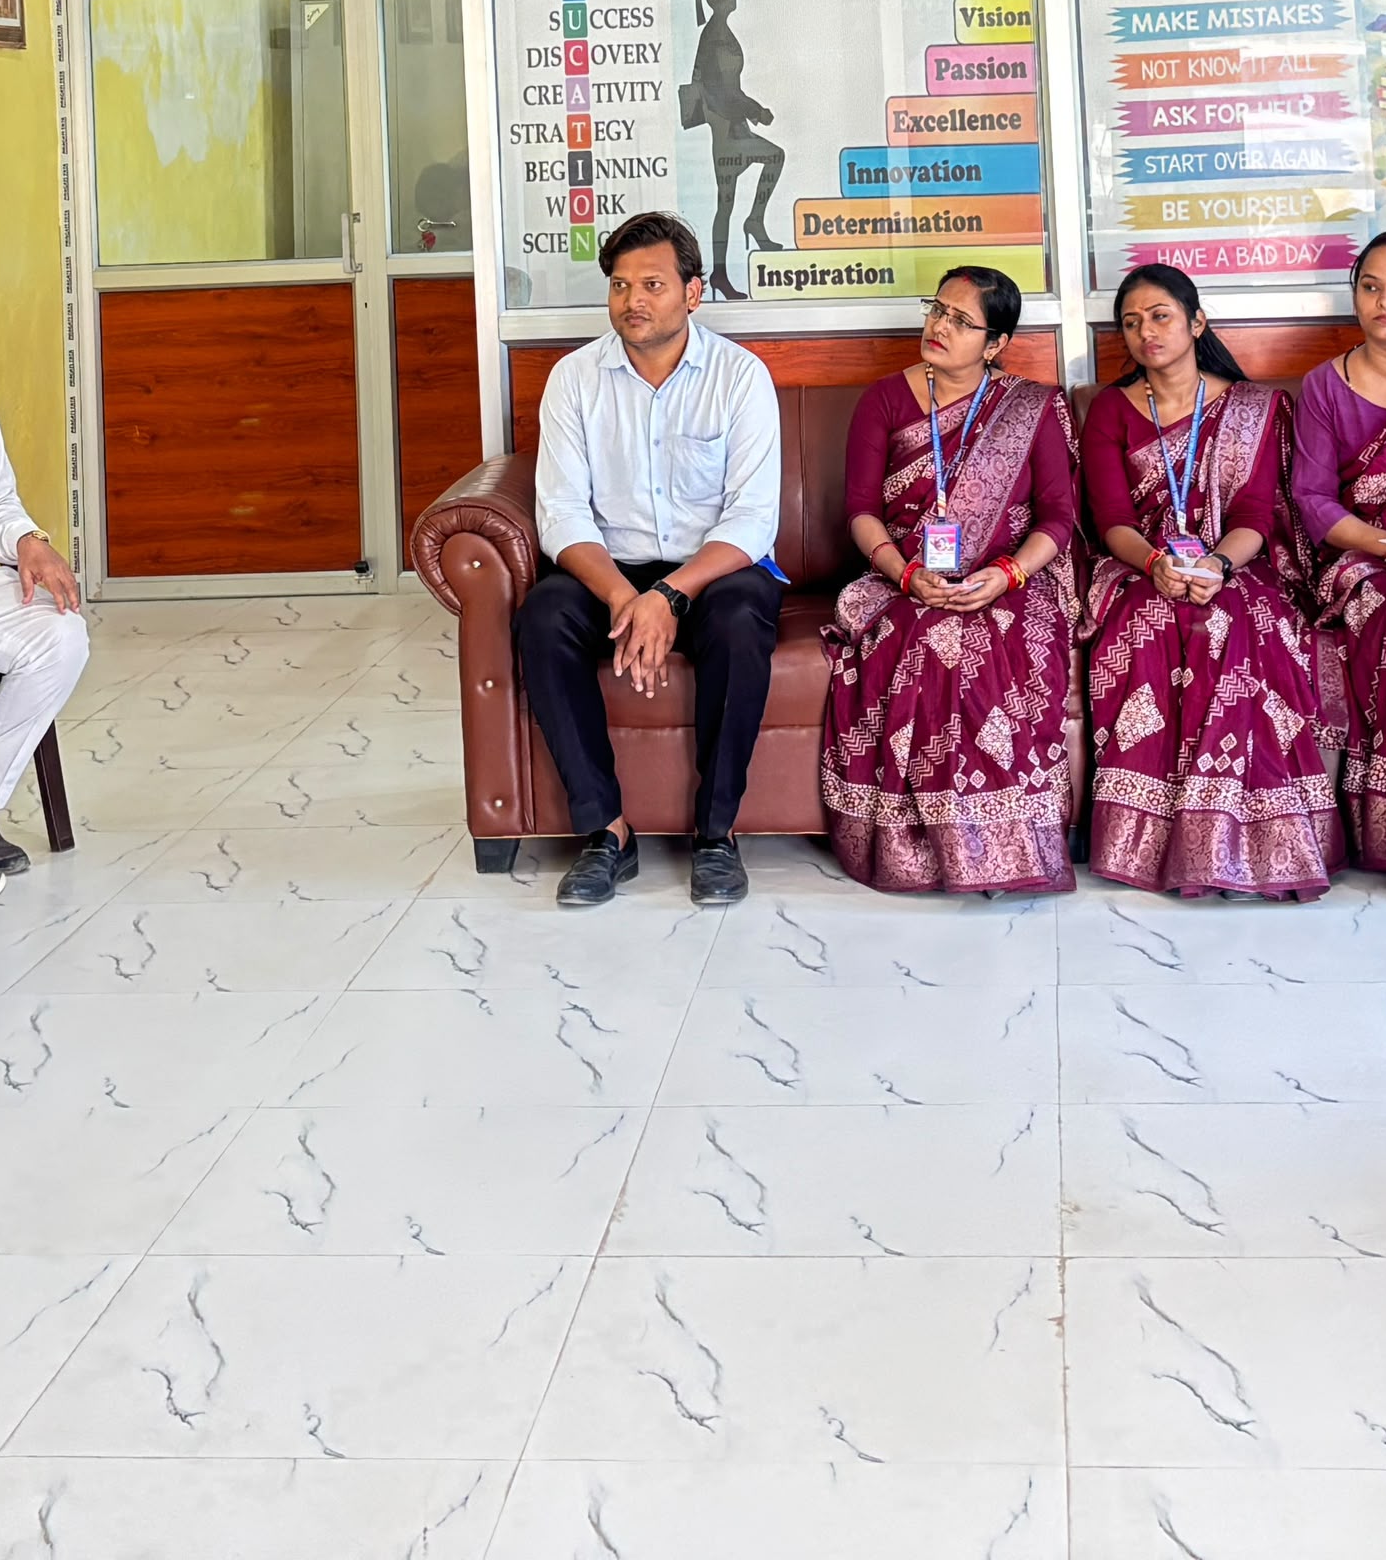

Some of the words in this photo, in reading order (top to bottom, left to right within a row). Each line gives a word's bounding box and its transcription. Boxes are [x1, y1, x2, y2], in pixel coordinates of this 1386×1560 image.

[549, 7, 654, 32] SUCCESS
[959, 6, 1032, 27] Vision
[1131, 10, 1200, 34] MAKE
[1207, 4, 1324, 30] MISTAKES
[526, 43, 662, 68] DISCOVERY
[934, 58, 1027, 81] Passion
[1141, 59, 1180, 81] NOT
[1188, 56, 1244, 78] KNOW
[522, 81, 663, 106] CREATIVITY
[893, 109, 1022, 133] Excellence
[1152, 106, 1197, 127] ASK
[1205, 102, 1248, 125] FOR
[510, 120, 635, 145] STRATEGY
[525, 157, 668, 182] BEGINNING
[847, 159, 982, 185] Innovation
[1145, 153, 1209, 174] START
[1214, 150, 1267, 171] OVER
[1270, 148, 1328, 169] AGAIN
[546, 194, 626, 218] WORK
[1162, 200, 1190, 222] BE
[1198, 194, 1315, 220] YOURSELF
[802, 211, 983, 238] Determination
[522, 230, 610, 254] SCIENC
[1157, 247, 1208, 268] HAVE
[1215, 246, 1230, 268] A
[1236, 244, 1278, 267] BAD
[1285, 243, 1326, 265] DAY
[757, 263, 895, 291] Inspiration
